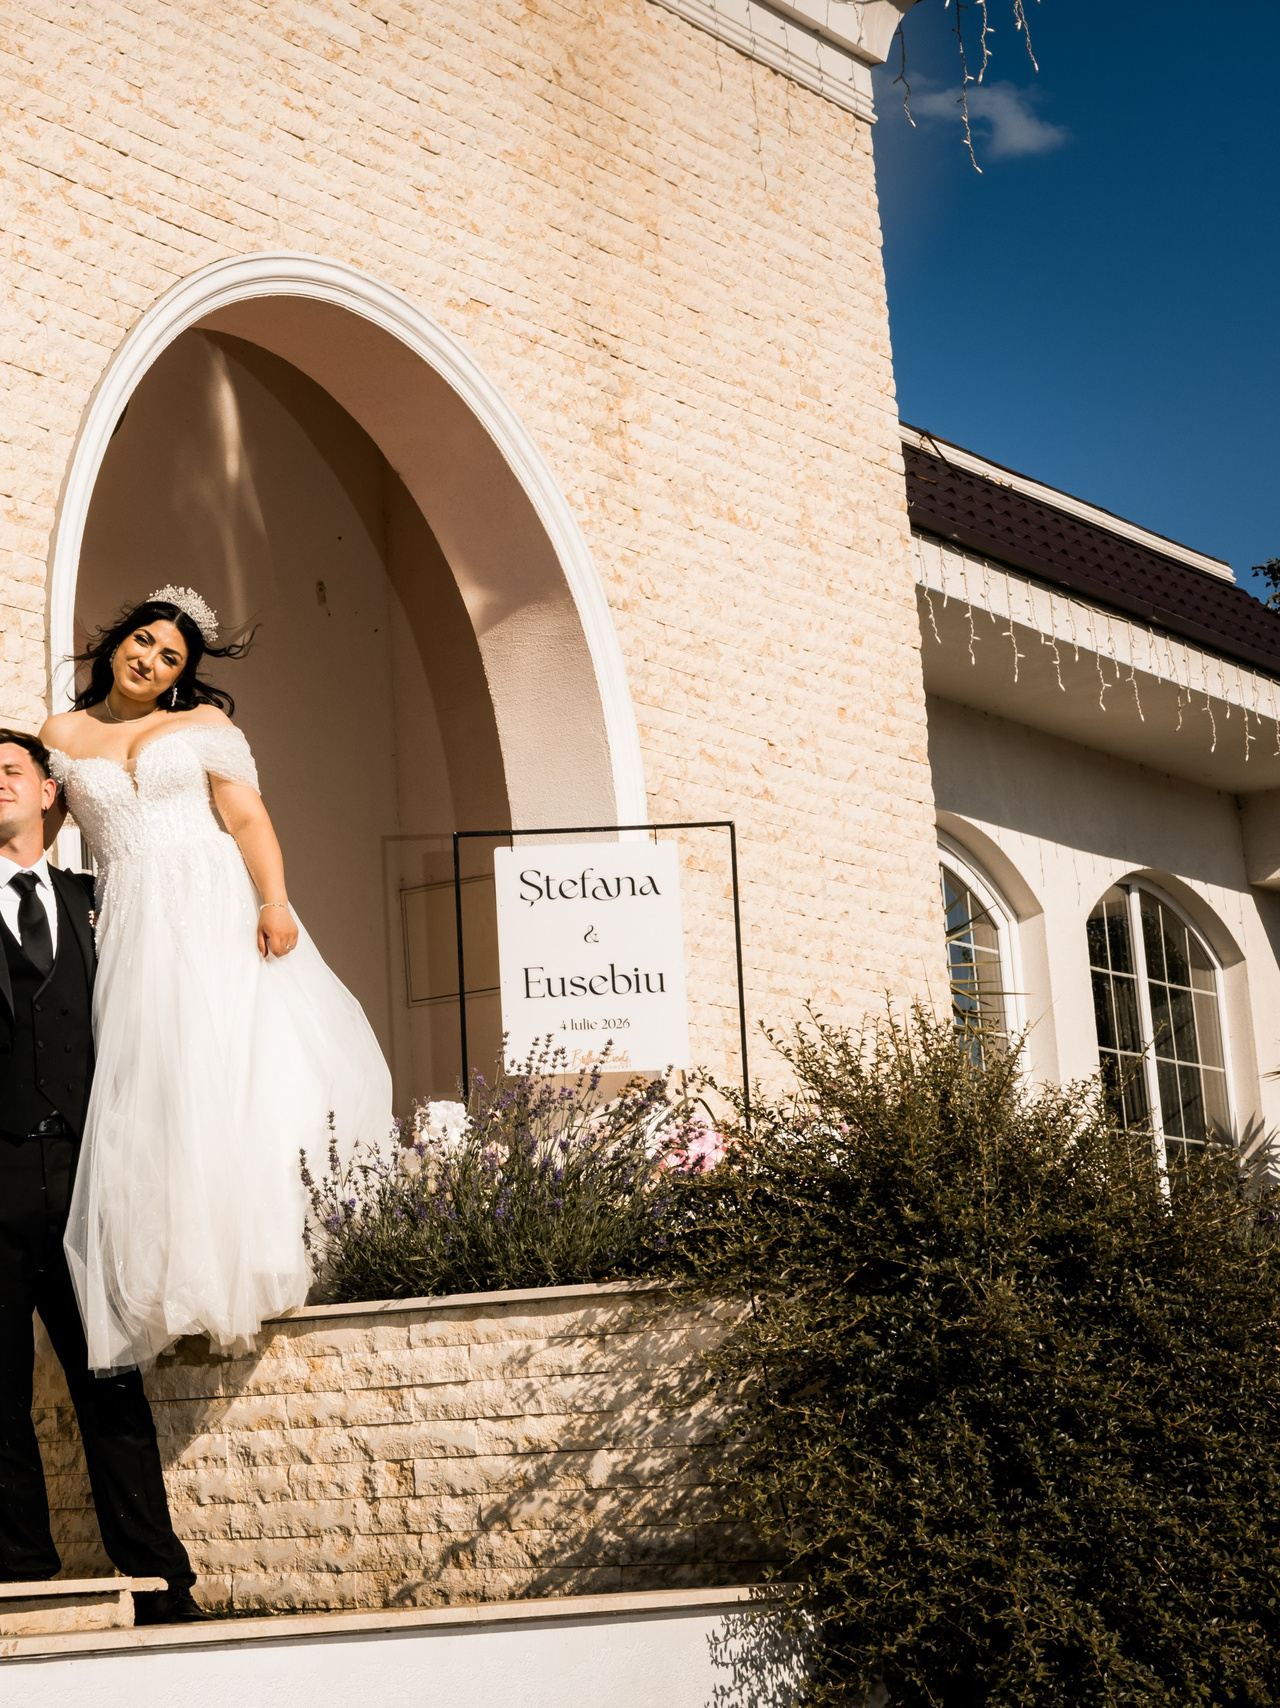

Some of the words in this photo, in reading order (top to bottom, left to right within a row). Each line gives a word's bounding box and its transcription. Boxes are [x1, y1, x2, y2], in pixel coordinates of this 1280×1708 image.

[519, 867, 662, 907] Ștefana
[583, 924, 600, 944] &
[522, 963, 667, 999] Eusebiu
[559, 1020, 567, 1031] 4
[570, 1018, 598, 1031] Iulie
[601, 1017, 631, 1030] 2026
